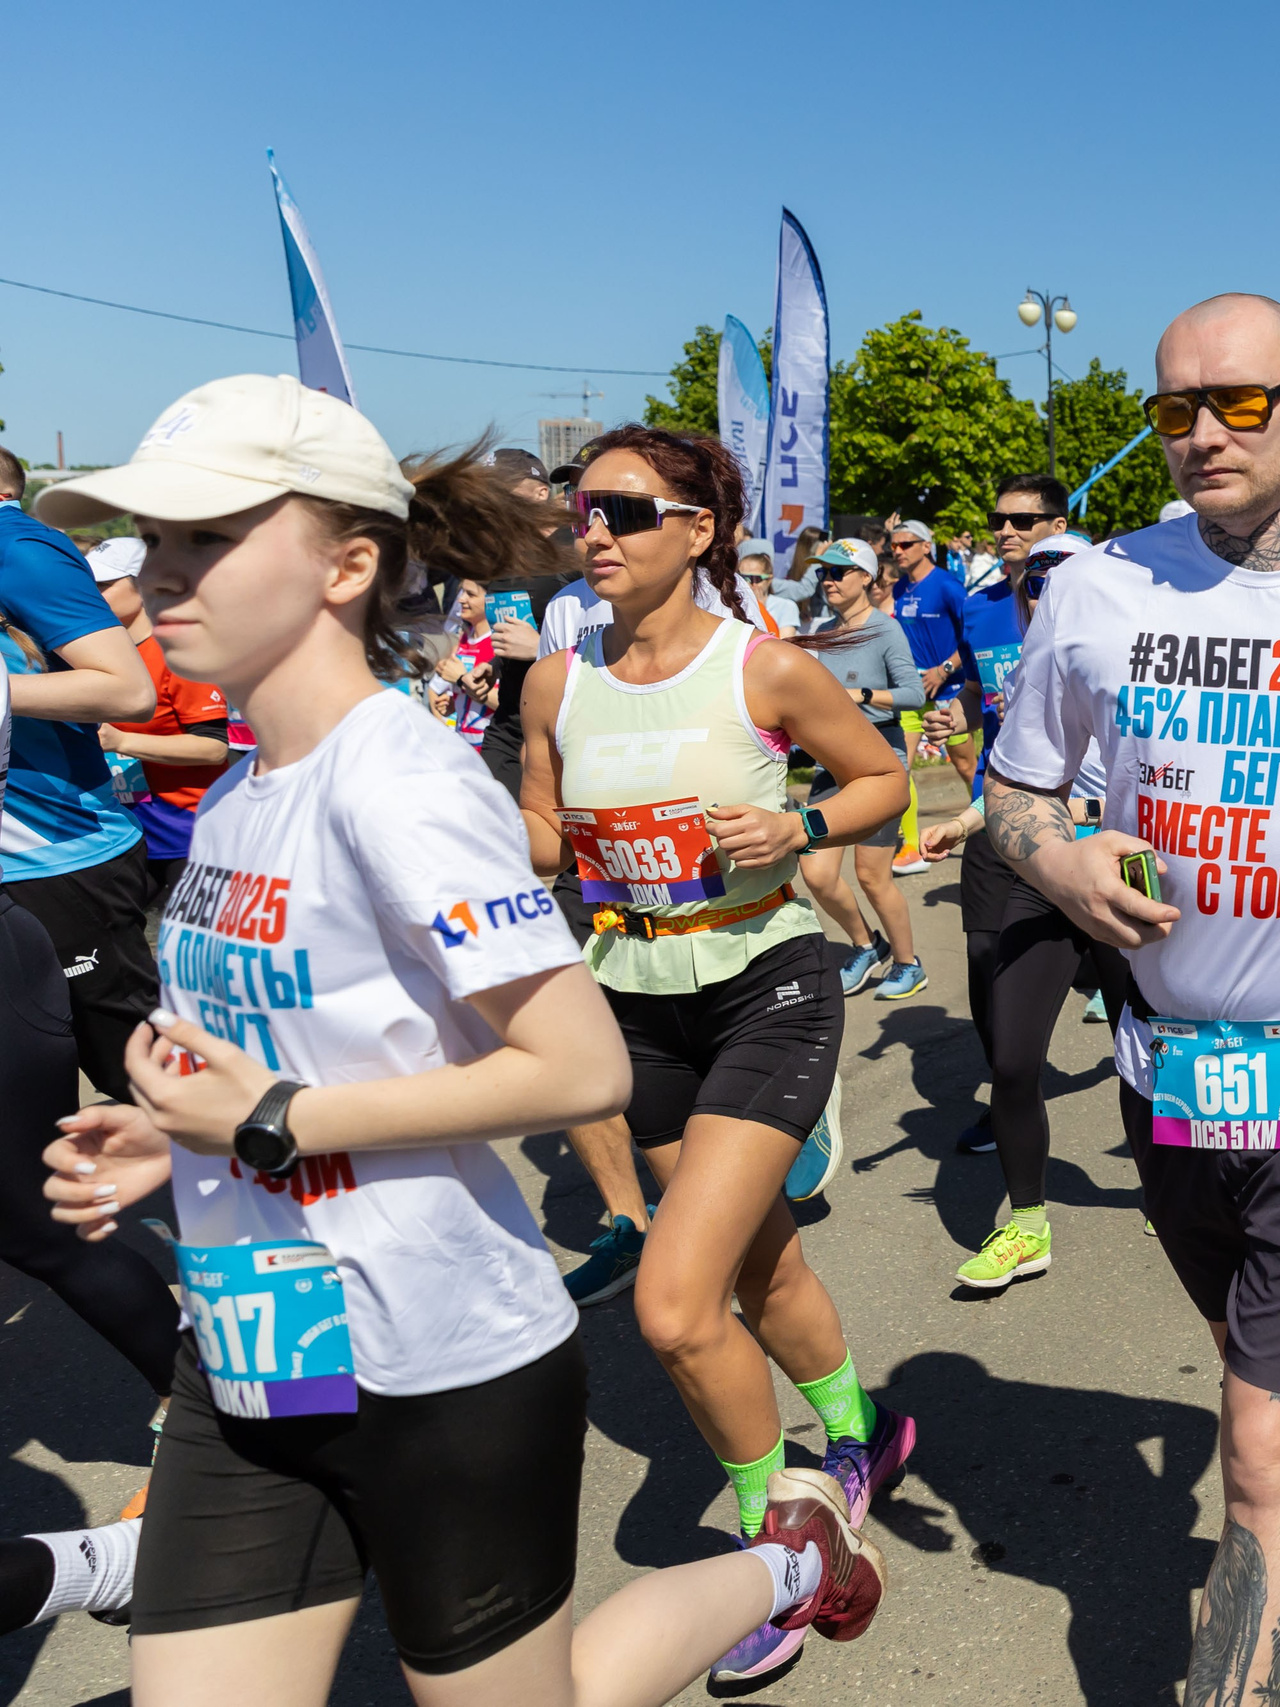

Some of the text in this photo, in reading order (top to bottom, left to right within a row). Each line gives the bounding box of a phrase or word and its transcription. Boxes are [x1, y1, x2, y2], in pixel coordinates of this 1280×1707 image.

[1115, 685, 1189, 742] 45%
[1162, 767, 1195, 791] БЕГ
[571, 812, 585, 821] ПСБ
[624, 820, 637, 831] БЕГ
[1138, 794, 1271, 863] ВМЕСТЕ
[596, 836, 682, 881] 5033
[485, 887, 553, 929] ПСБ
[1196, 863, 1222, 916] С
[656, 890, 780, 931] OWERUP
[63, 960, 94, 978] UMA
[176, 929, 314, 1010] ПЛАНЕТЫ
[767, 993, 814, 1012] NORDSKI
[1167, 1026, 1183, 1035] ПСБ
[1227, 1036, 1244, 1048] БЕГ
[1194, 1052, 1268, 1116] 651
[1190, 1119, 1278, 1150] ПСБ 5 КМ
[190, 1291, 278, 1374] 317
